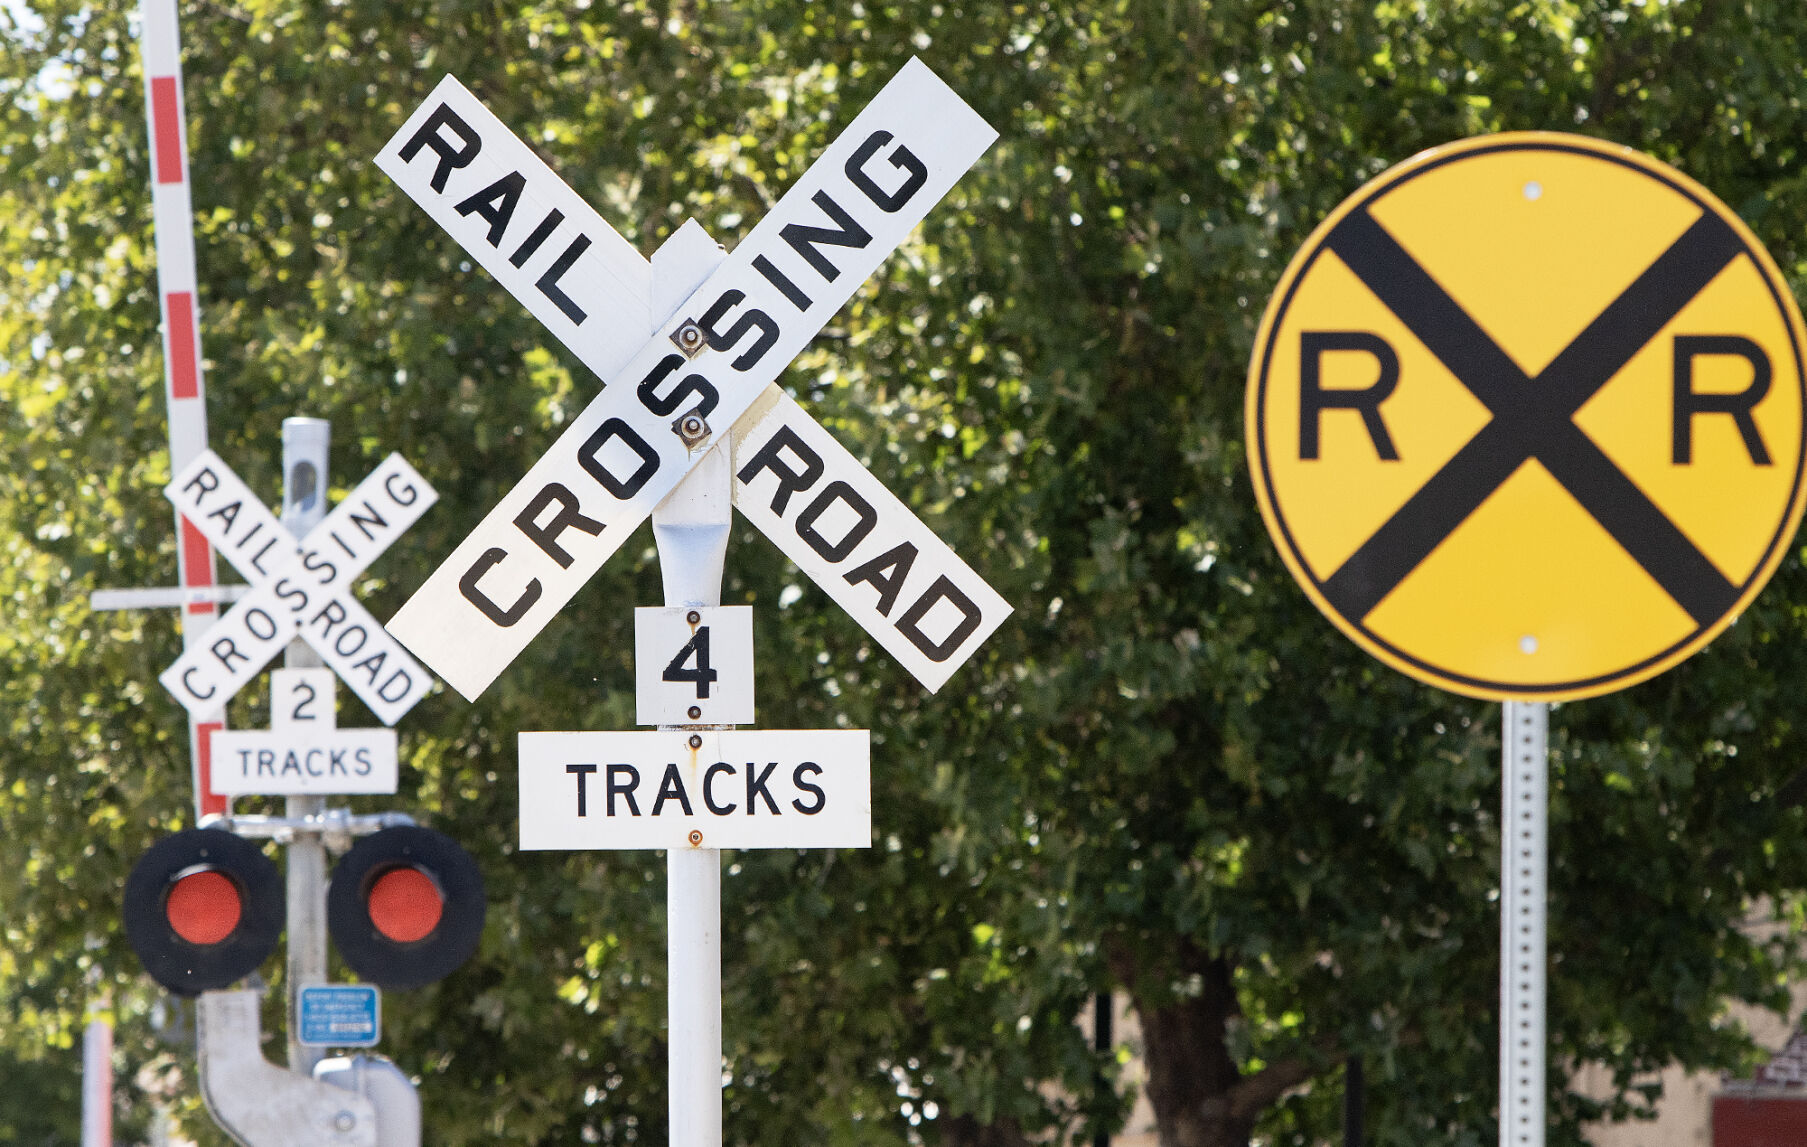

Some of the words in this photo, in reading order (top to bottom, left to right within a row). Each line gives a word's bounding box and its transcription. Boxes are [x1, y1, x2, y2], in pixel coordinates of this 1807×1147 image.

[397, 101, 592, 327] RAIL
[736, 425, 983, 663] ROAD
[458, 129, 928, 628] CROSSING
[1298, 329, 1401, 461] R
[1671, 335, 1774, 465] R
[181, 473, 418, 701] CROSSING
[183, 467, 277, 577] RAIL
[310, 600, 412, 704] ROAD
[291, 682, 316, 720] 2
[662, 625, 718, 700] 4
[237, 748, 372, 777] TRACKS
[566, 760, 827, 817] TRACKS
